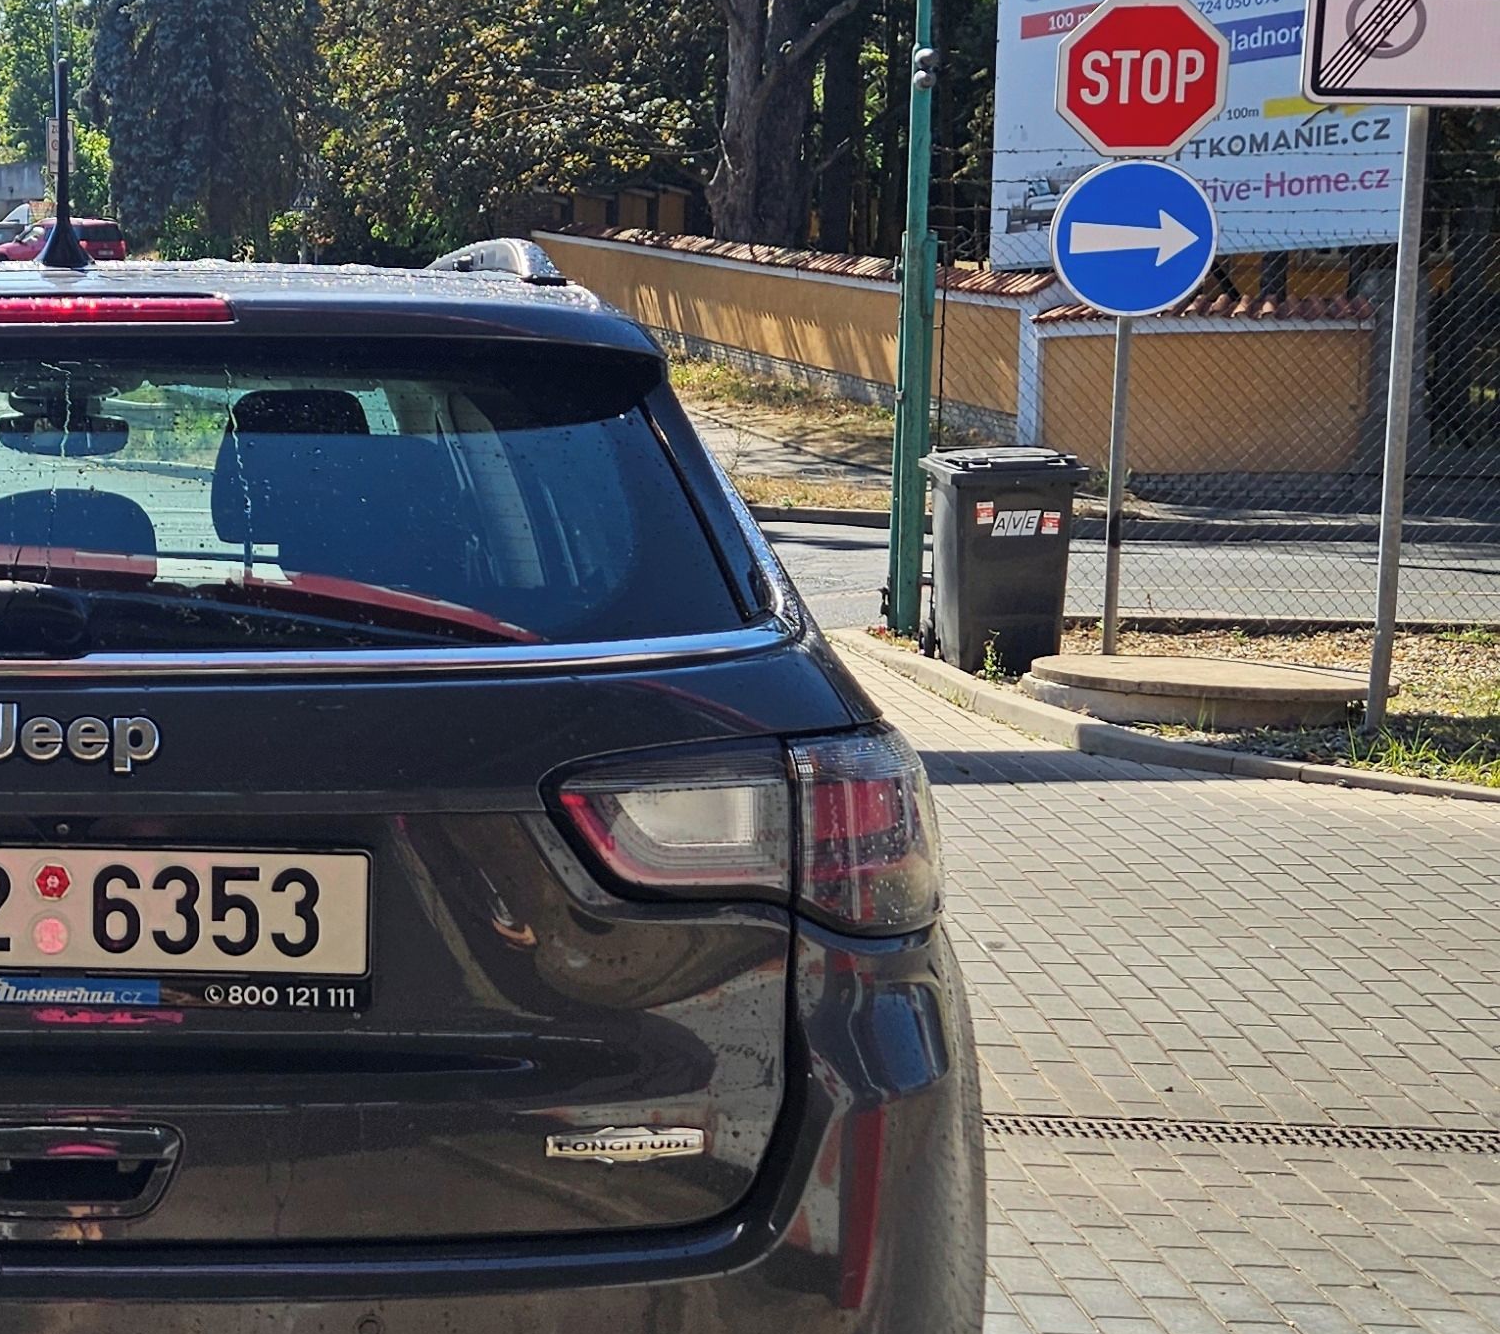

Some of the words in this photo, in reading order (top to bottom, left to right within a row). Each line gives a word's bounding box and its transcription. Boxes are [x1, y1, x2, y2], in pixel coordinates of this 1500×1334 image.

[1198, 0, 1221, 14] 724
[1049, 12, 1074, 31] 100
[1229, 25, 1304, 52] ladnor
[1080, 49, 1206, 105] STOP
[1227, 107, 1259, 120] 100m
[1114, 118, 1391, 162] TKOMANIE.CZ
[995, 516, 1036, 530] AVE
[92, 866, 320, 956] 6353
[228, 986, 279, 1005] 800
[286, 987, 319, 1007] 121
[327, 988, 355, 1007] 111
[556, 1139, 695, 1152] LONGITUDE
